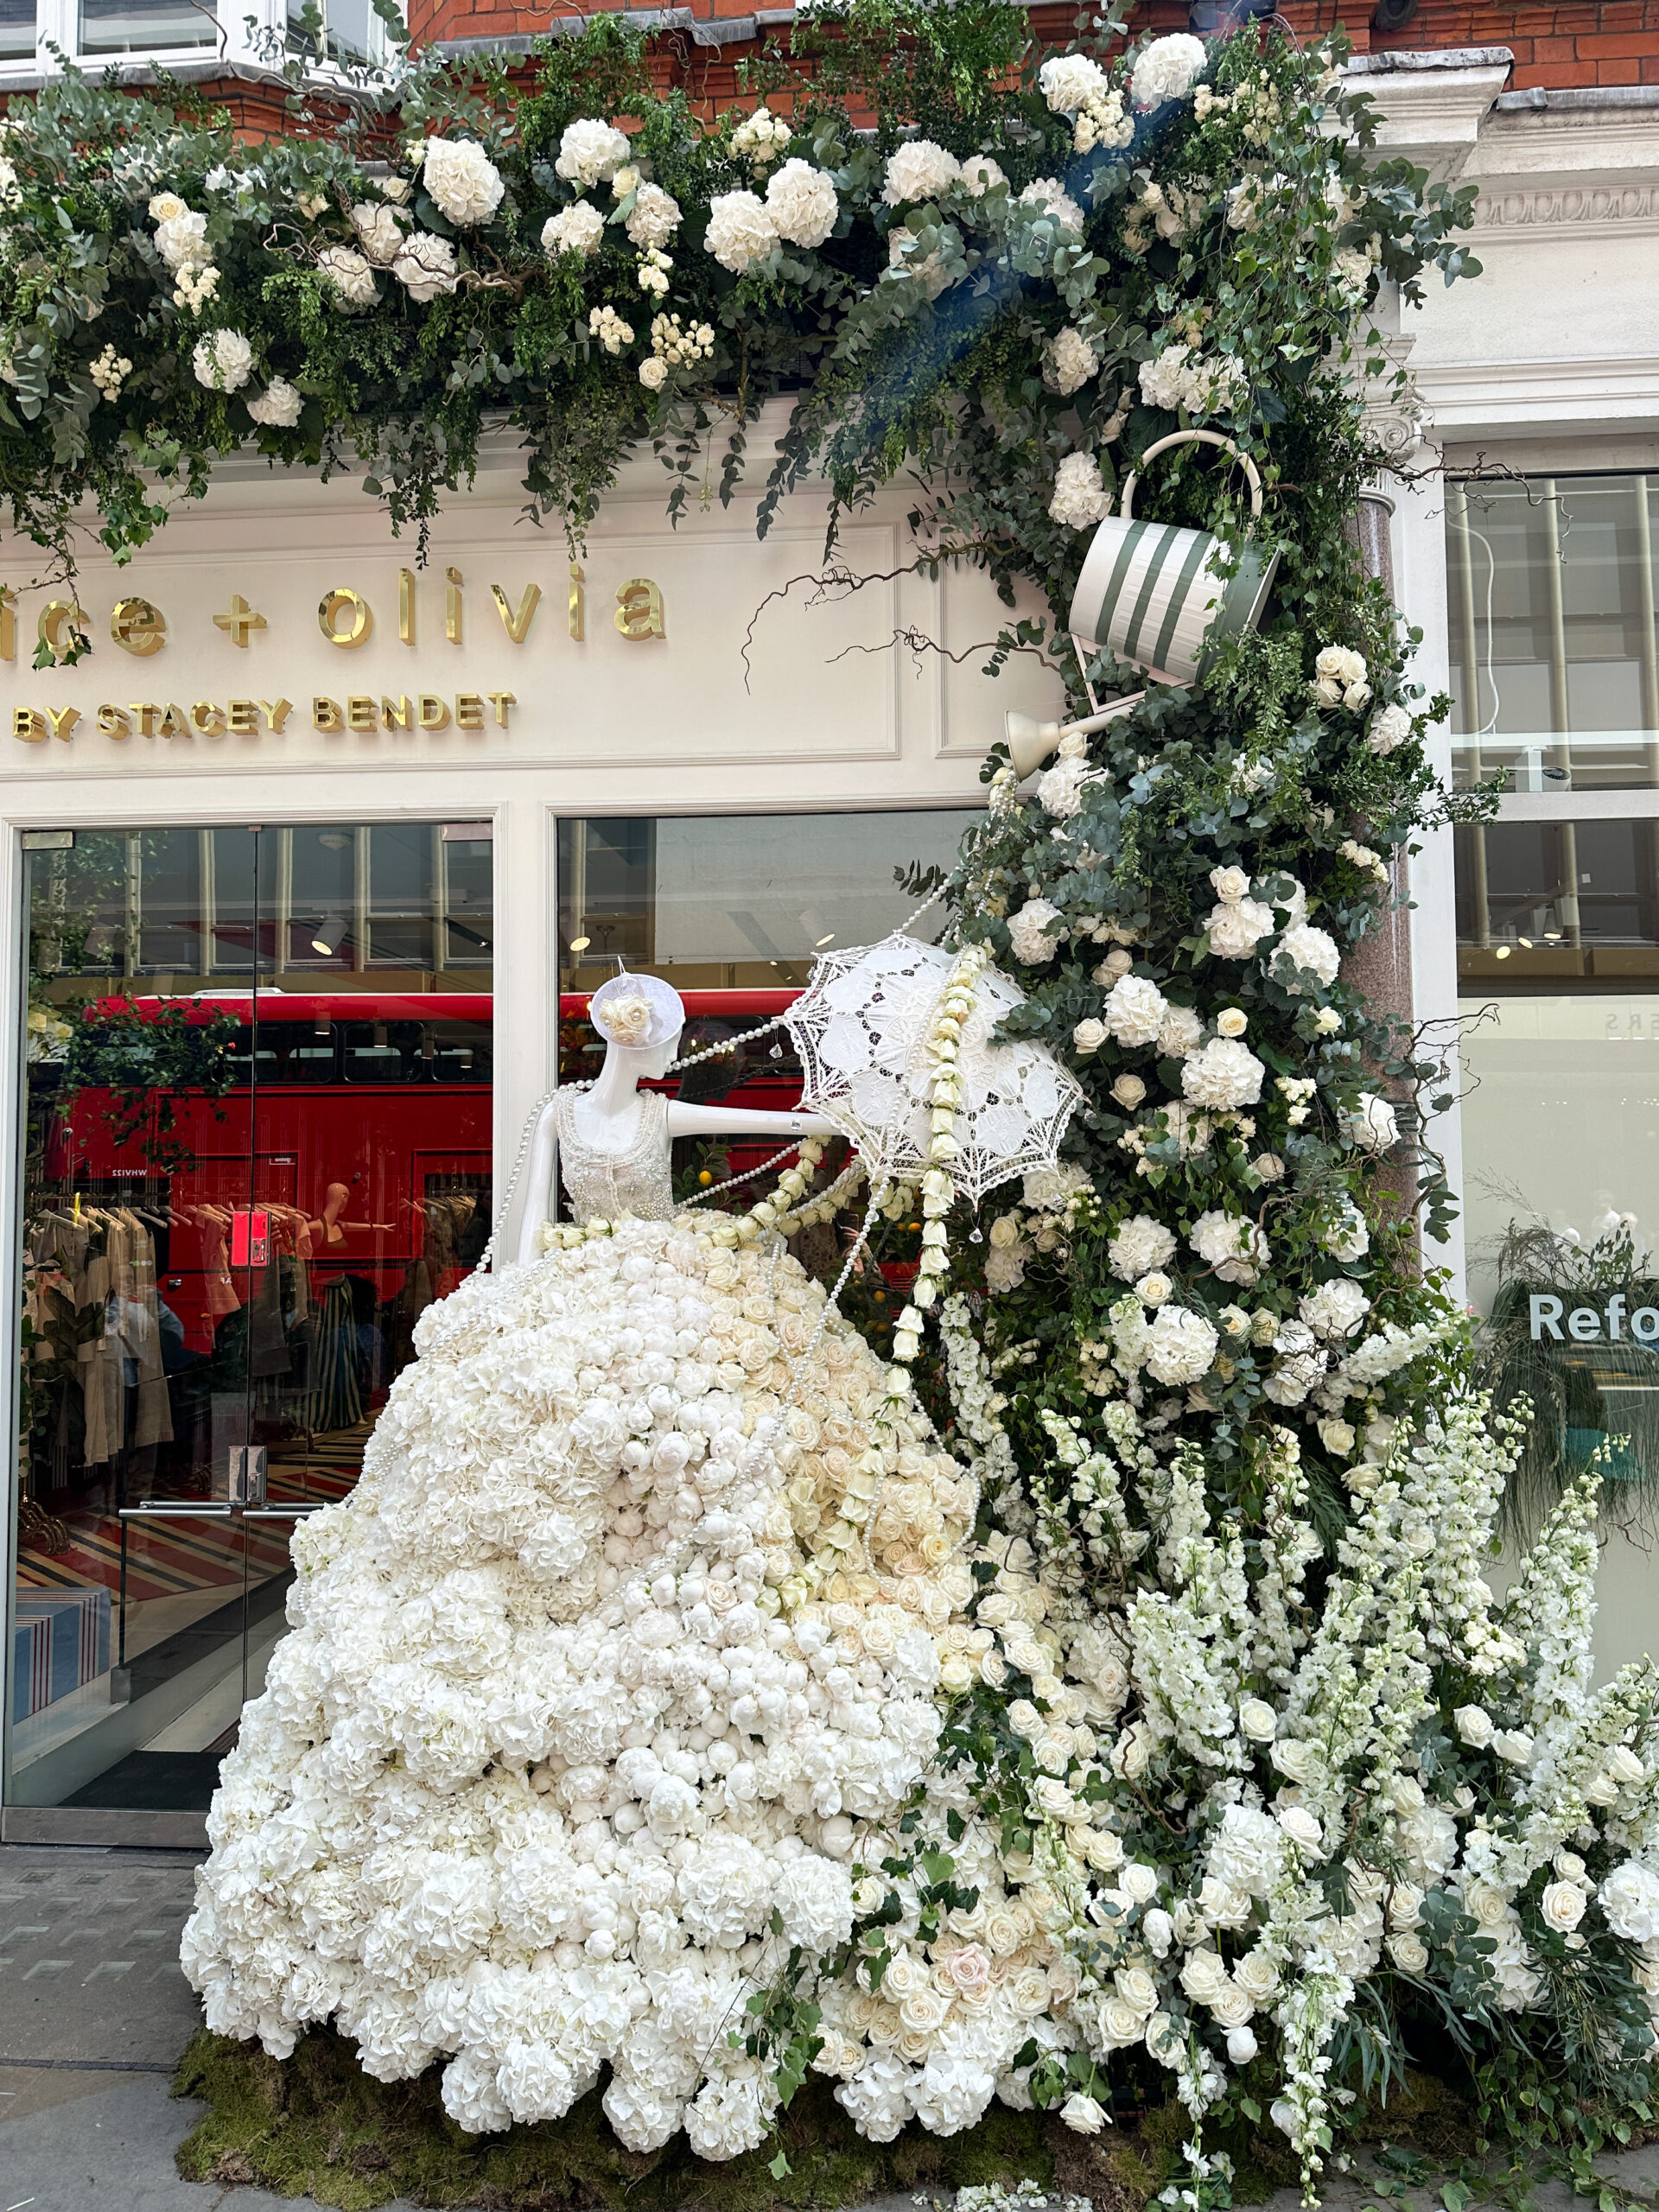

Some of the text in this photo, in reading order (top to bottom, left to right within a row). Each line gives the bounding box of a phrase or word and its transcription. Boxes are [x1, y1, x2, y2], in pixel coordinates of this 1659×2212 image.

[213, 594, 267, 648] +
[318, 564, 666, 649] olivia
[13, 691, 517, 742] BY STACEY BENDET
[1529, 1294, 1659, 1340] Refo
